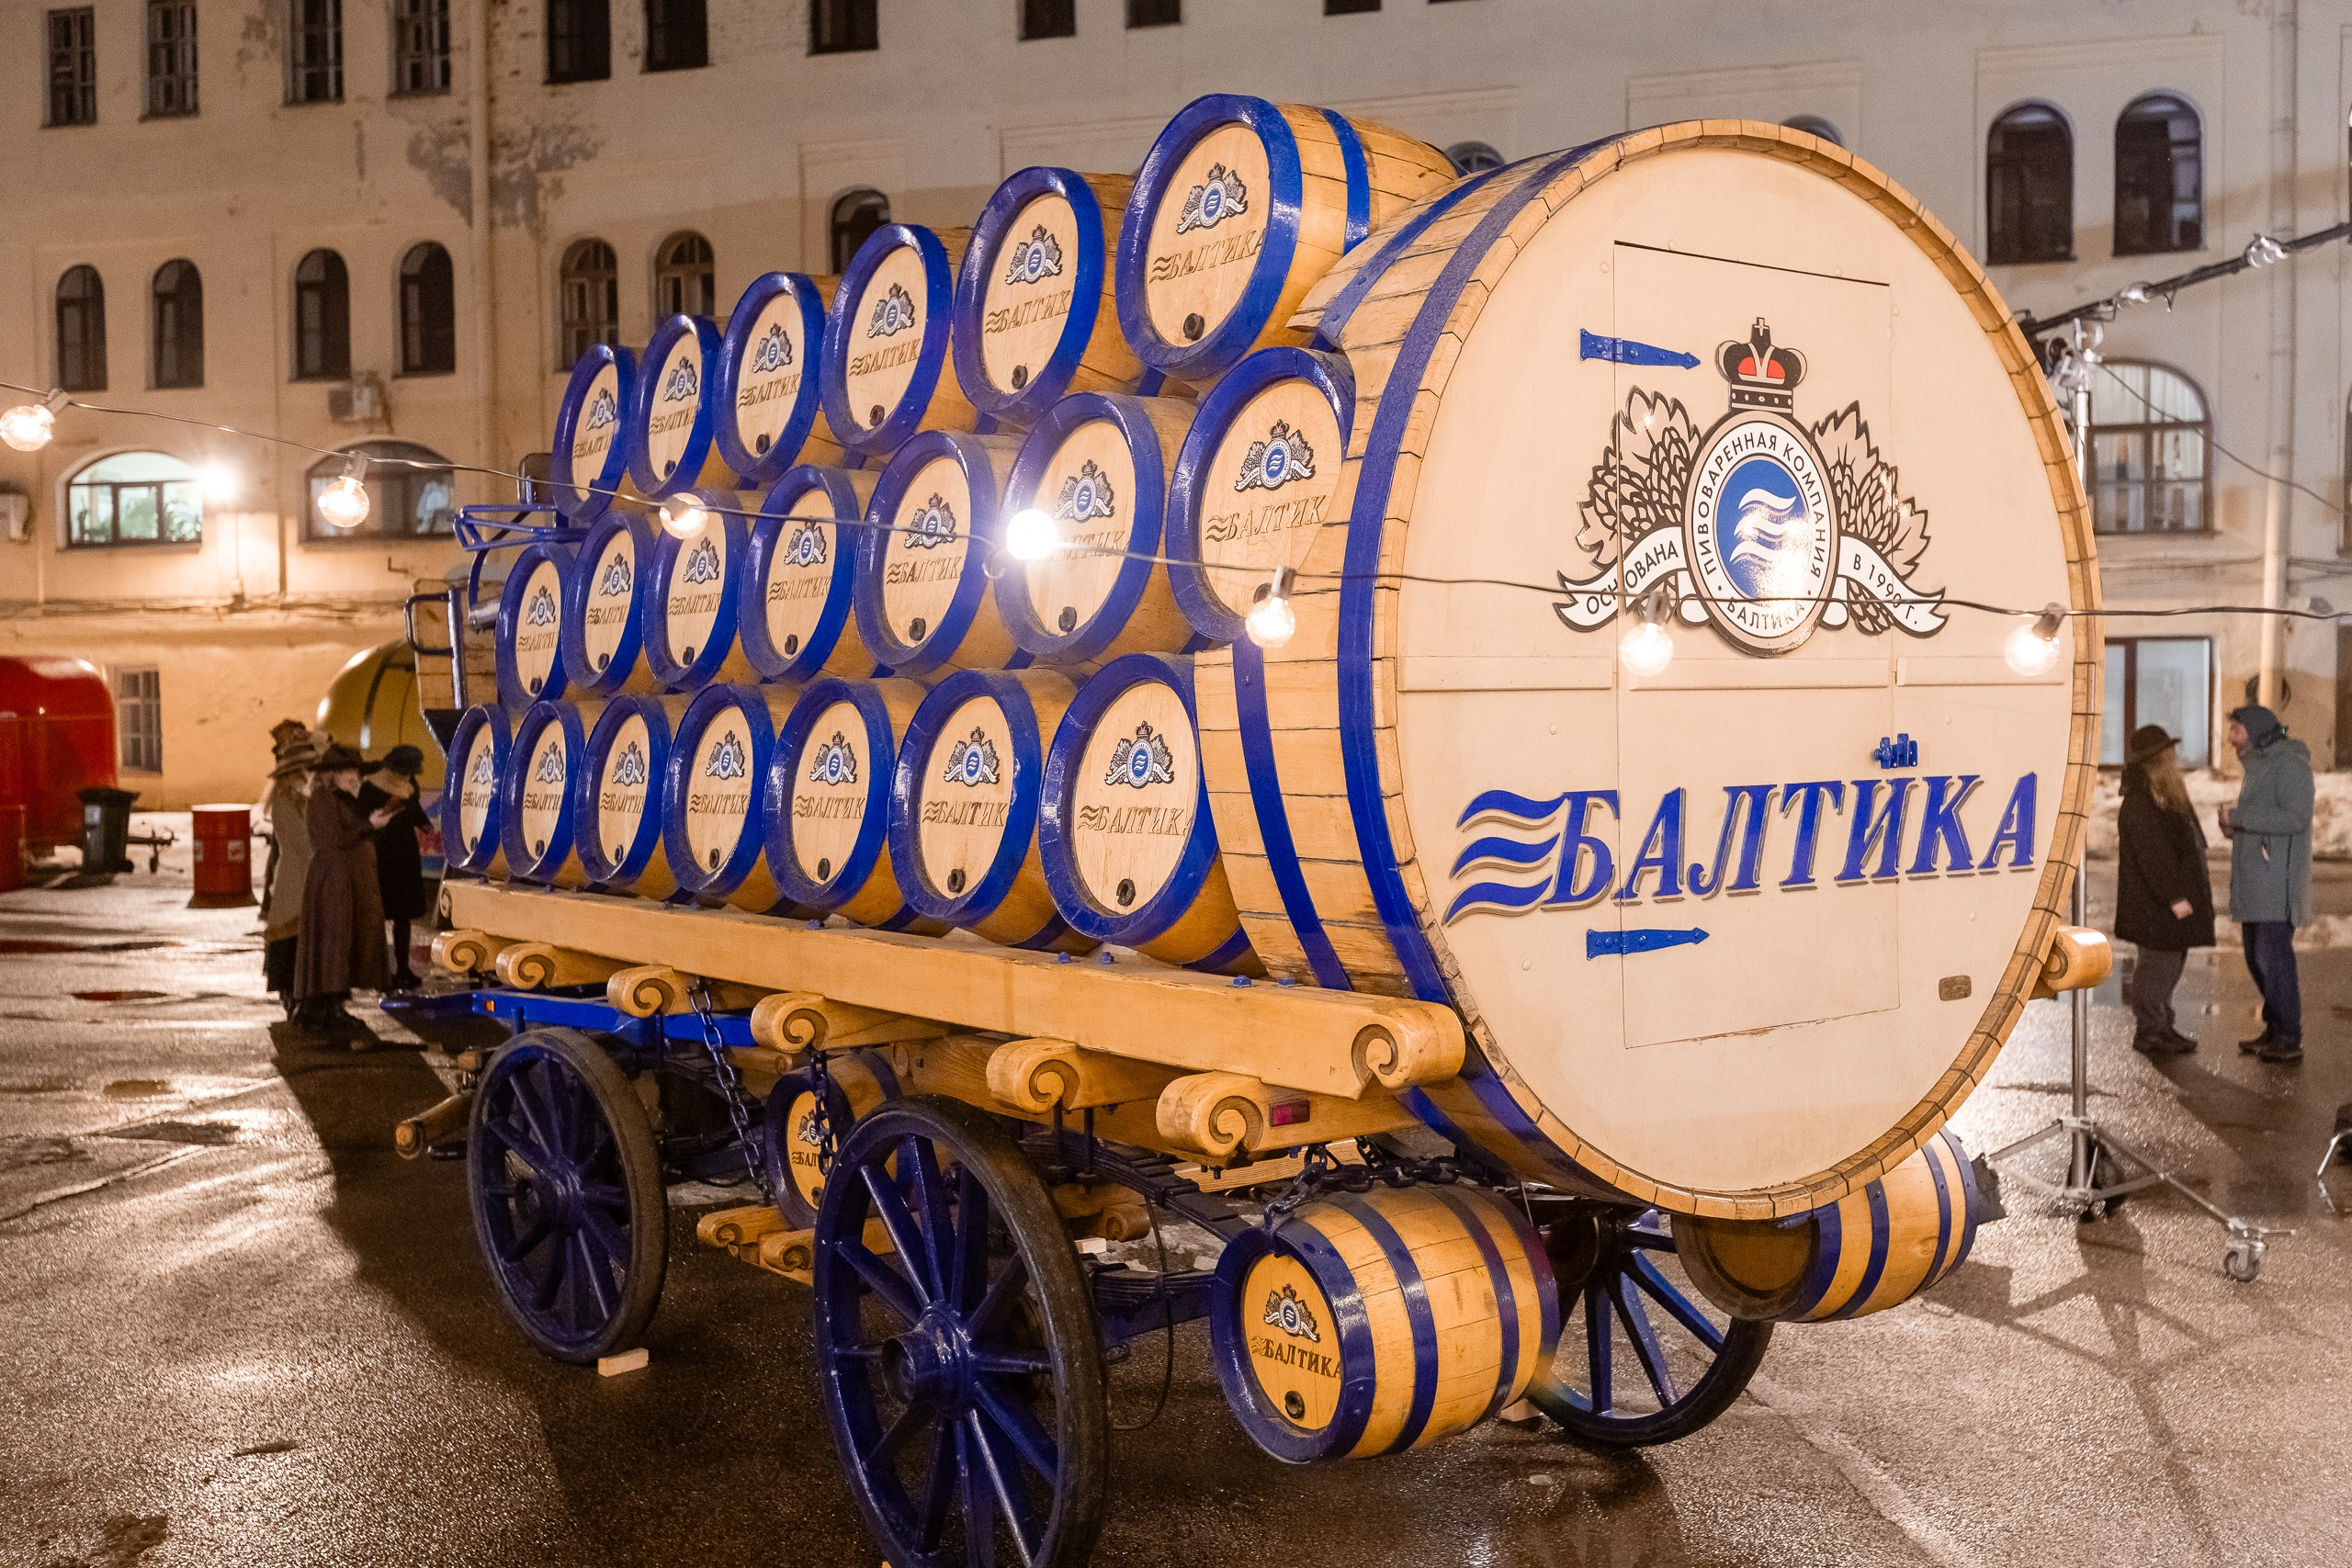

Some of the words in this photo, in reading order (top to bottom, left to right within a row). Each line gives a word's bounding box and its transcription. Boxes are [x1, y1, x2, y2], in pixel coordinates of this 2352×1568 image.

[999, 289, 1071, 333] БАЛТИК
[862, 338, 921, 376] БАЛТИК
[748, 373, 800, 406] БАЛТИК
[1223, 494, 1328, 541] БАЛТИК
[1698, 432, 1777, 576] ПИВОВАРЕННАЯ
[1783, 443, 1826, 579] КОМПАНИЯ
[899, 556, 962, 584] БАЛТИК
[1586, 540, 1679, 615] ОСНОВАНА
[1868, 564, 1902, 608] 1990
[779, 576, 831, 601] БАЛТИК
[699, 794, 749, 814] БАЛТИК
[806, 795, 865, 819] БАЛТИК
[936, 801, 1008, 827] БАЛТИК
[1541, 771, 2037, 912] БАЛТИКА
